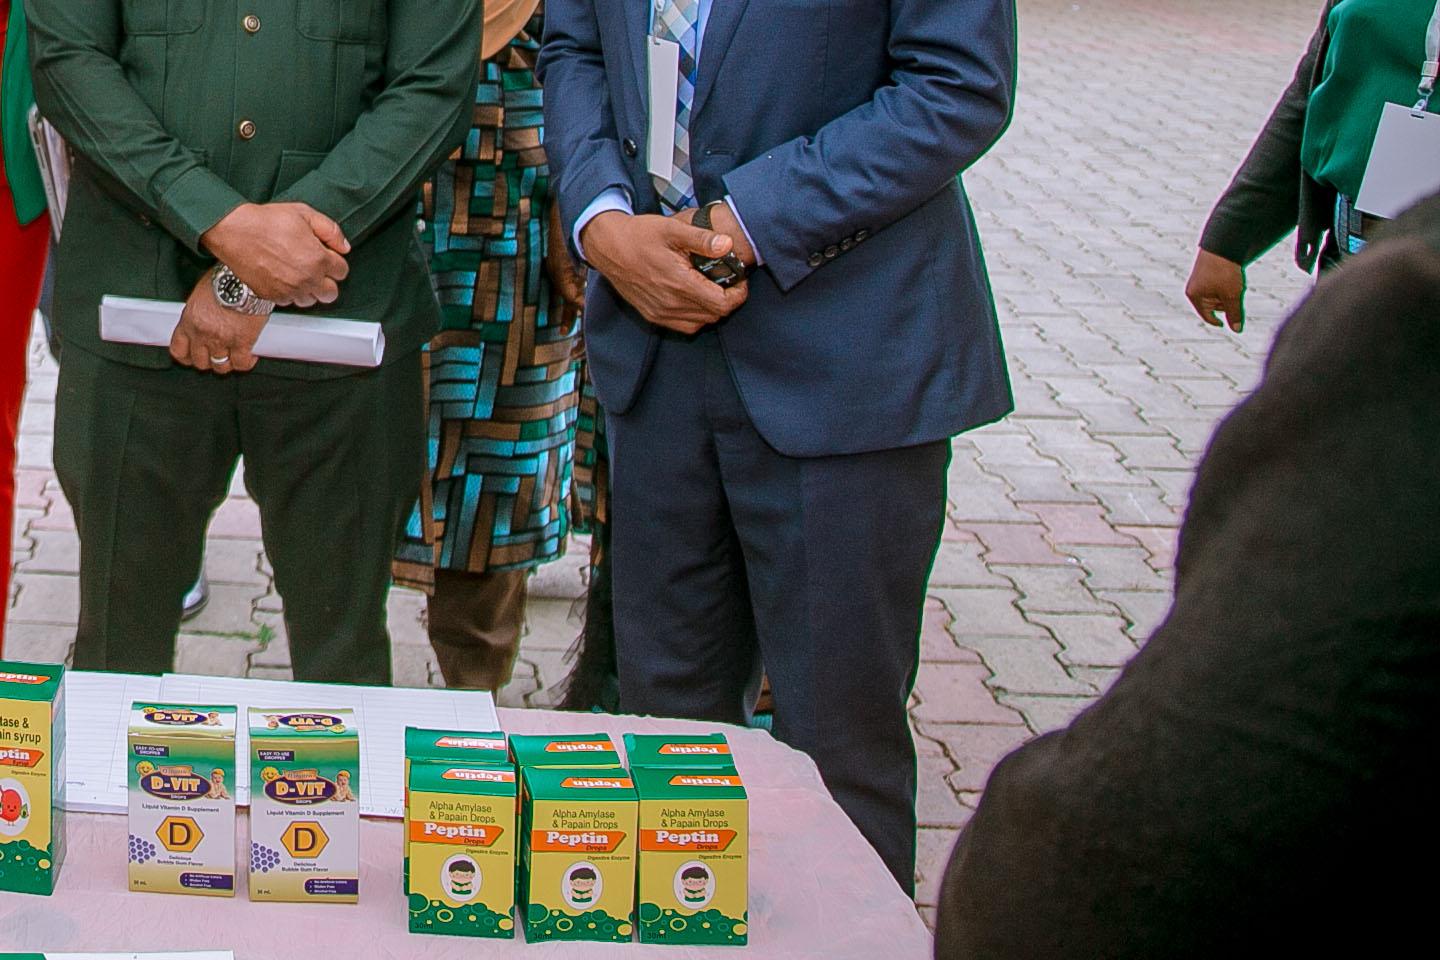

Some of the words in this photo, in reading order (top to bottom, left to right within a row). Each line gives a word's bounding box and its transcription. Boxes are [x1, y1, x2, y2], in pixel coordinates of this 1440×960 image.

[22, 718, 30, 729] &
[13, 732, 41, 745] syrup
[557, 744, 604, 752] Peptin
[669, 746, 718, 754] Peptin
[455, 771, 503, 781] Peptin
[680, 777, 731, 786] Peptin
[150, 776, 201, 792] D-VIT
[275, 781, 326, 796] D-VIT
[573, 780, 622, 789] Peptin
[142, 803, 159, 811] Liquid
[429, 801, 453, 812] Alpha
[455, 803, 492, 815] Amylase
[429, 811, 436, 819] &
[438, 812, 469, 822] Papain
[471, 814, 496, 824] Drops
[552, 809, 577, 819] Alpha
[579, 810, 615, 820] Amylase
[661, 808, 686, 819] Alpha
[687, 809, 725, 819] Amylase
[552, 819, 559, 828] &
[561, 820, 591, 829] Papain
[593, 820, 618, 829] Drops
[661, 819, 668, 827] &
[670, 819, 701, 829] Papain
[703, 819, 728, 829] Drops
[169, 822, 191, 845] D
[424, 822, 486, 838] Peptin
[294, 828, 316, 851] D
[546, 831, 608, 846] Peptin
[656, 830, 719, 845] Peptin
[586, 844, 607, 852] Drops
[696, 844, 718, 852] Drops
[414, 921, 434, 930] 30ml
[647, 932, 667, 940] 30ml
